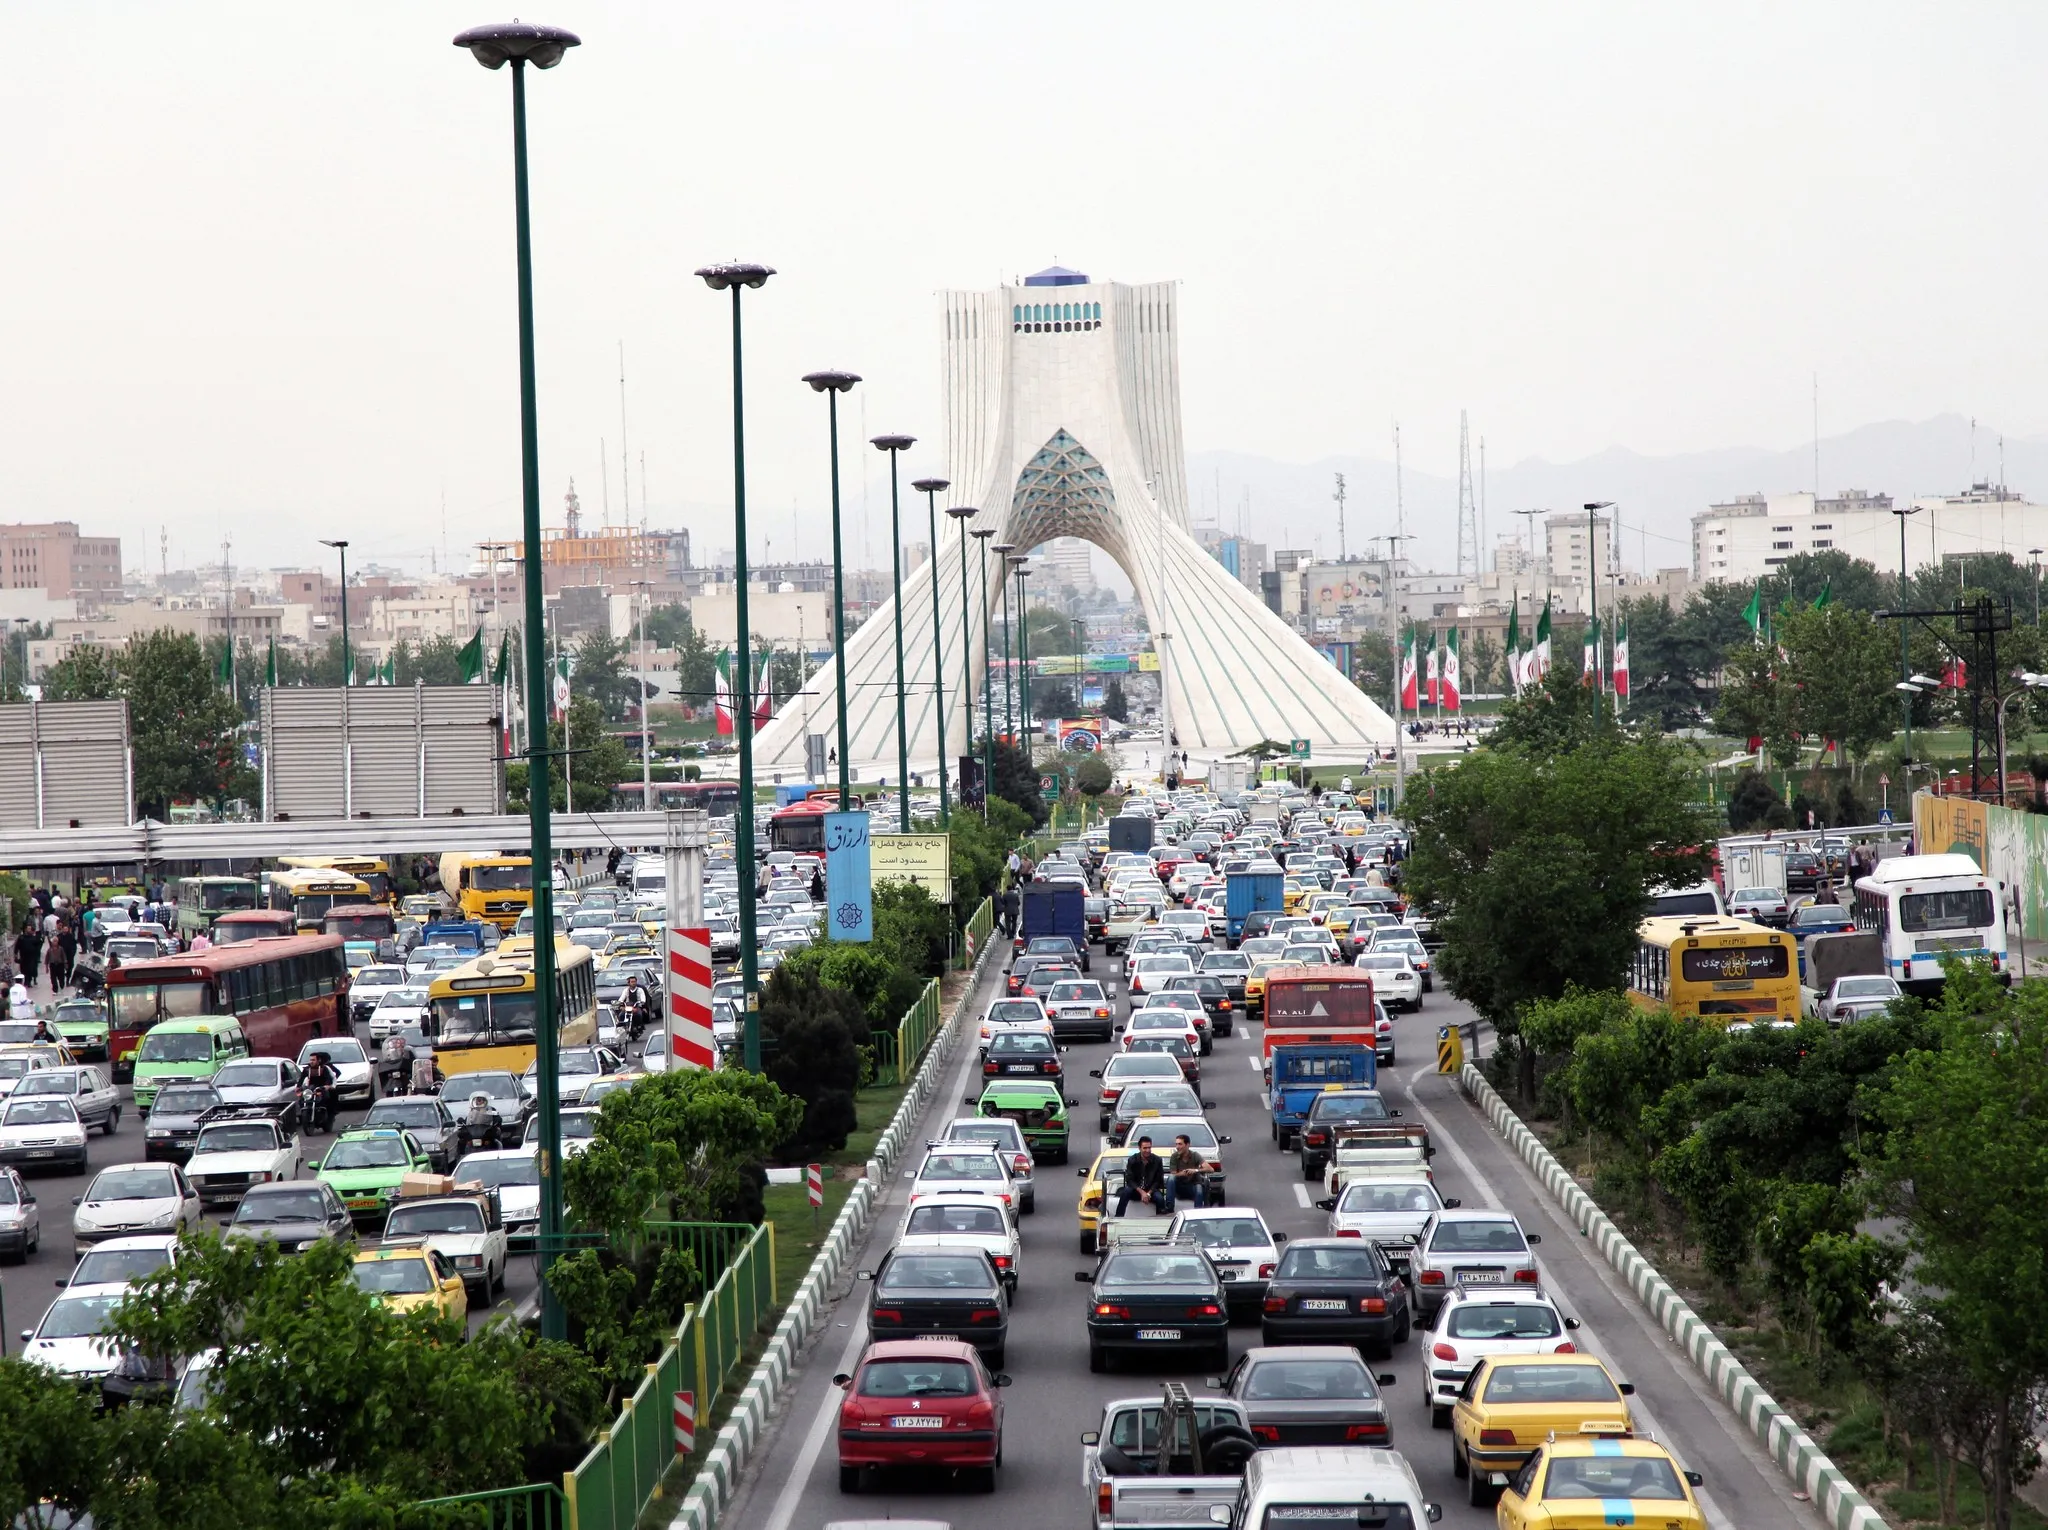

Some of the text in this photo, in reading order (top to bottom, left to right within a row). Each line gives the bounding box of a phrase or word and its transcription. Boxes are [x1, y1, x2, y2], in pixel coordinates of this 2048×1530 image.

[827, 825, 868, 852] الرزاق
[896, 839, 913, 850] شیخ
[924, 839, 942, 850] جناح
[878, 856, 898, 864] است
